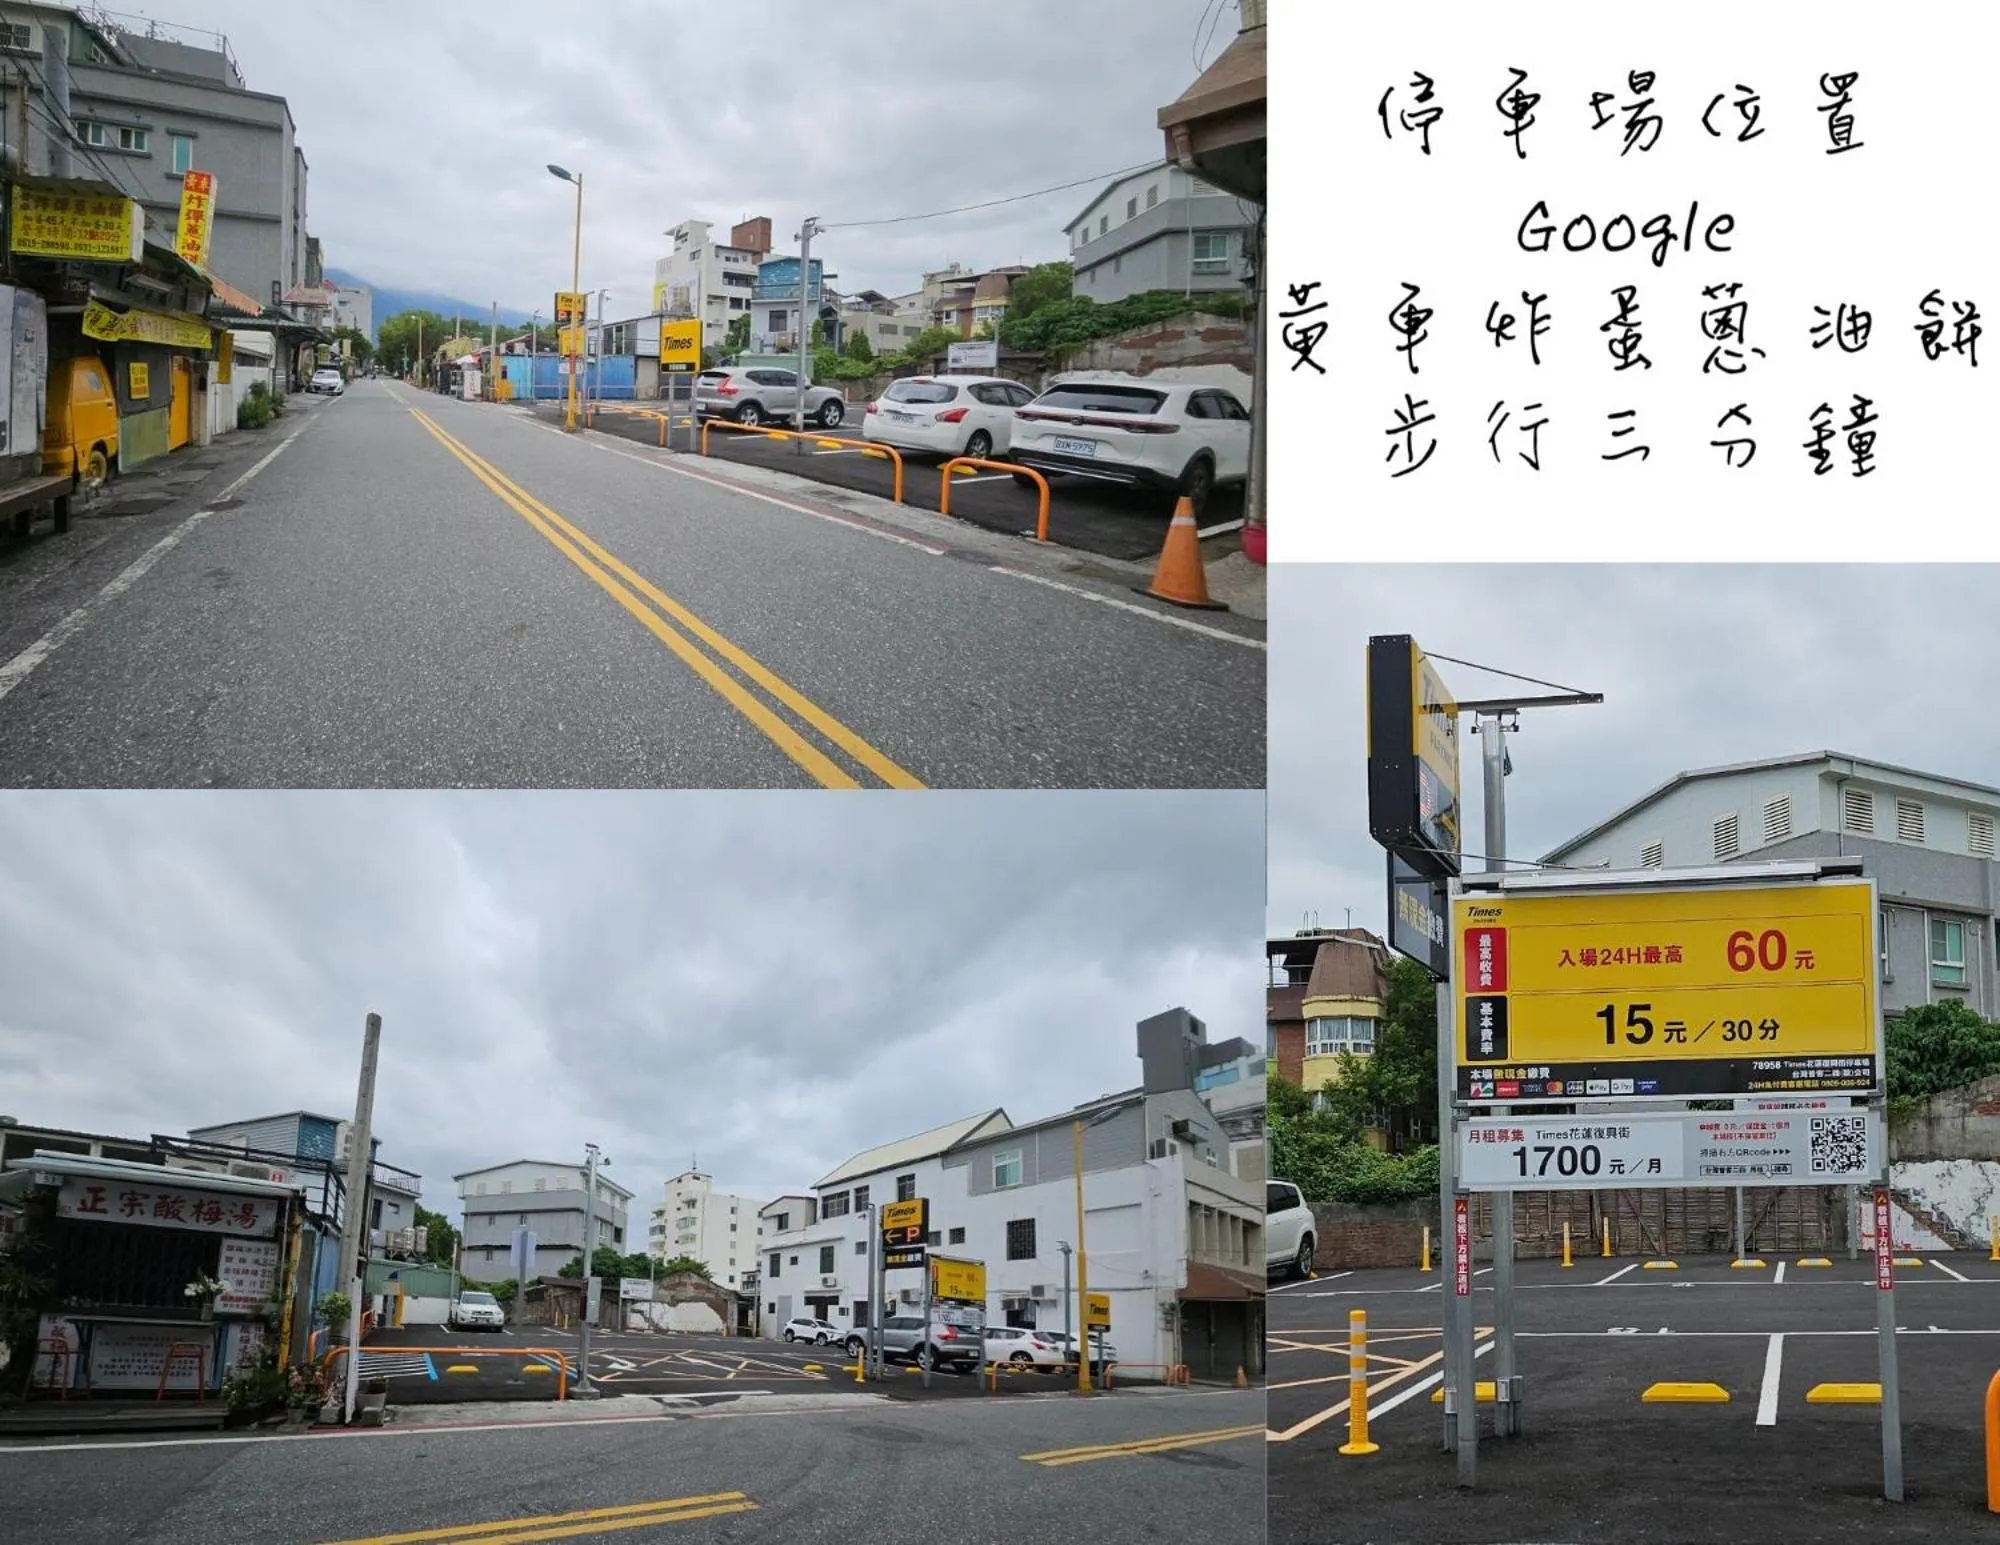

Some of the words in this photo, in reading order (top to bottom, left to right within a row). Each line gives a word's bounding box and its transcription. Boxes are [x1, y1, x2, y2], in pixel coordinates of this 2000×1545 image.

[664, 336, 693, 351] Times
[1467, 906, 1503, 917] Times
[1479, 934, 1493, 987] 最高收費
[1558, 945, 1683, 968] 入場24H最高
[1480, 1002, 1494, 1055] 基本費率
[1752, 1061, 1781, 1070] 78958
[1470, 1067, 1551, 1080] 本場無現金繳費
[1468, 1128, 1525, 1143] 月租募集
[1536, 1126, 1631, 1140] Times花蓮復興街
[77, 1186, 259, 1229] 正宗酸梅湯
[887, 1206, 917, 1218] Times
[907, 1227, 920, 1242] P
